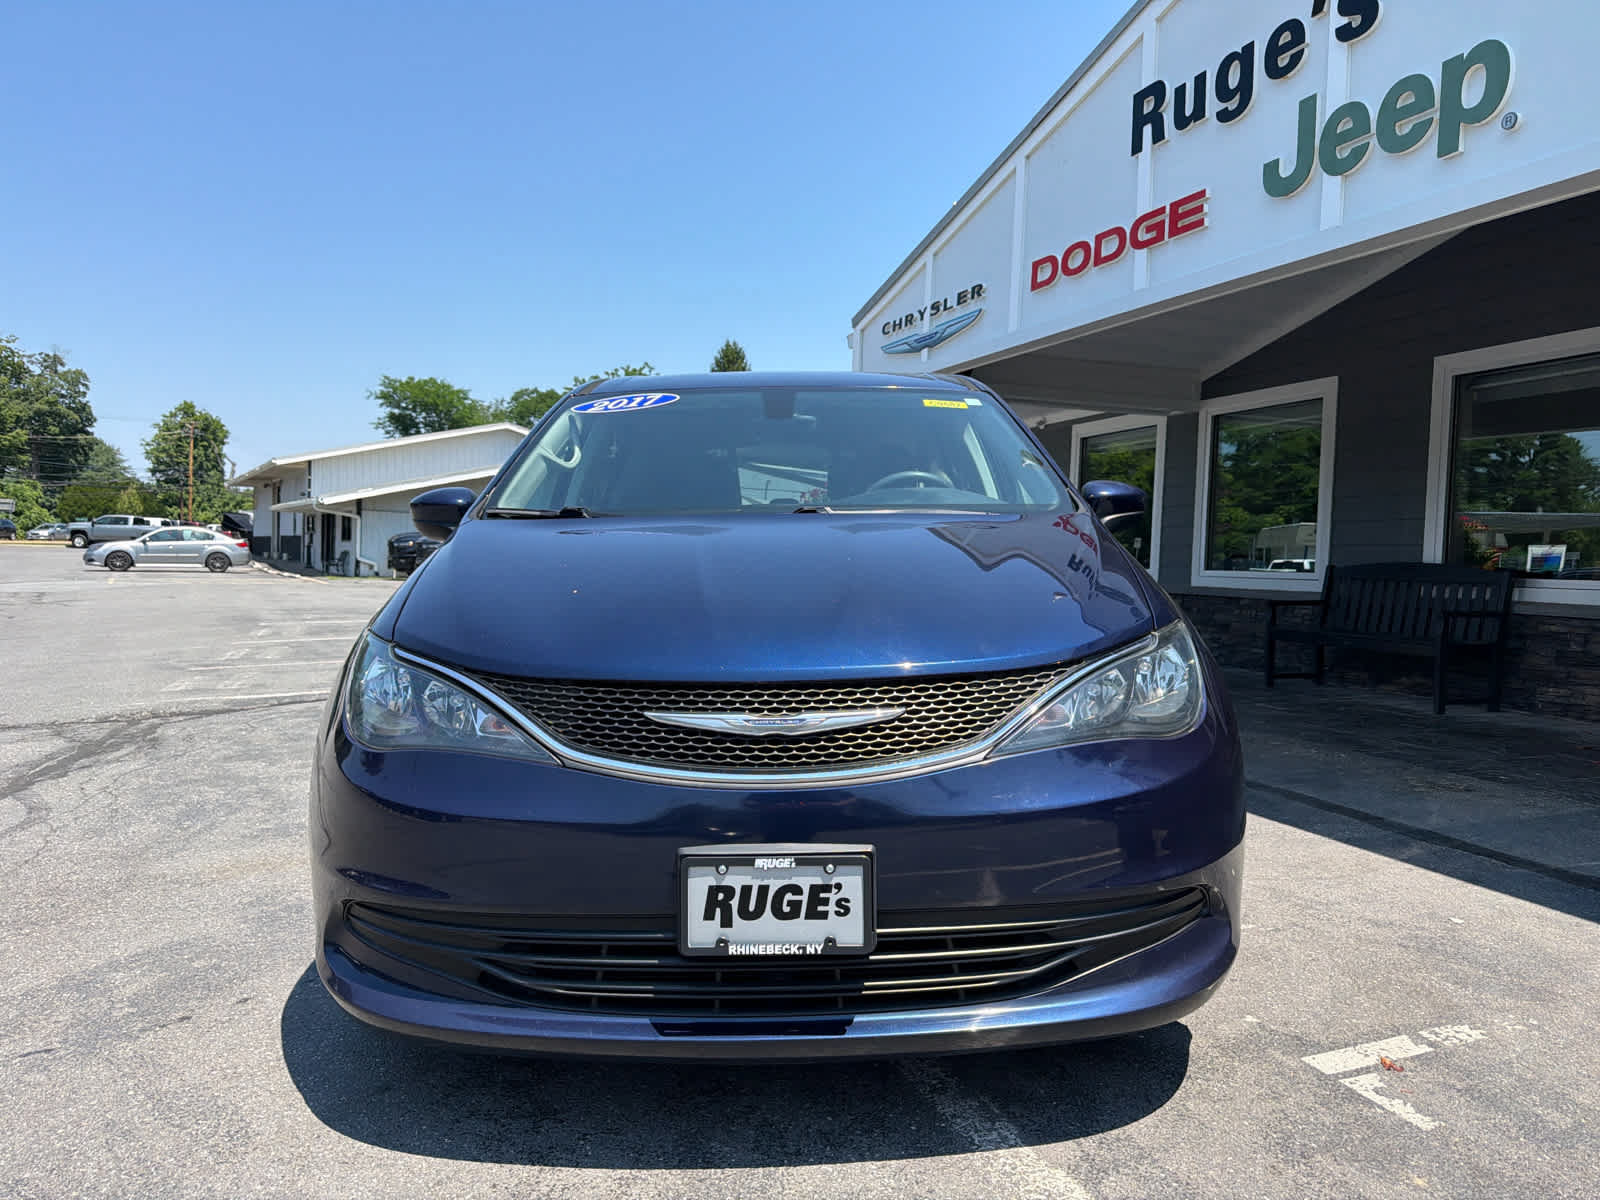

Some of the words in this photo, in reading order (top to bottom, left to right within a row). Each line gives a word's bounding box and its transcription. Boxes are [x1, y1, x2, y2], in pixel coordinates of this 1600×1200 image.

[1262, 39, 1512, 198] Jeep
[1030, 188, 1207, 293] DODGE
[881, 283, 984, 336] CHRYSLER
[588, 394, 663, 411] 2017
[702, 882, 851, 928] RUGE's
[806, 943, 824, 955] NY
